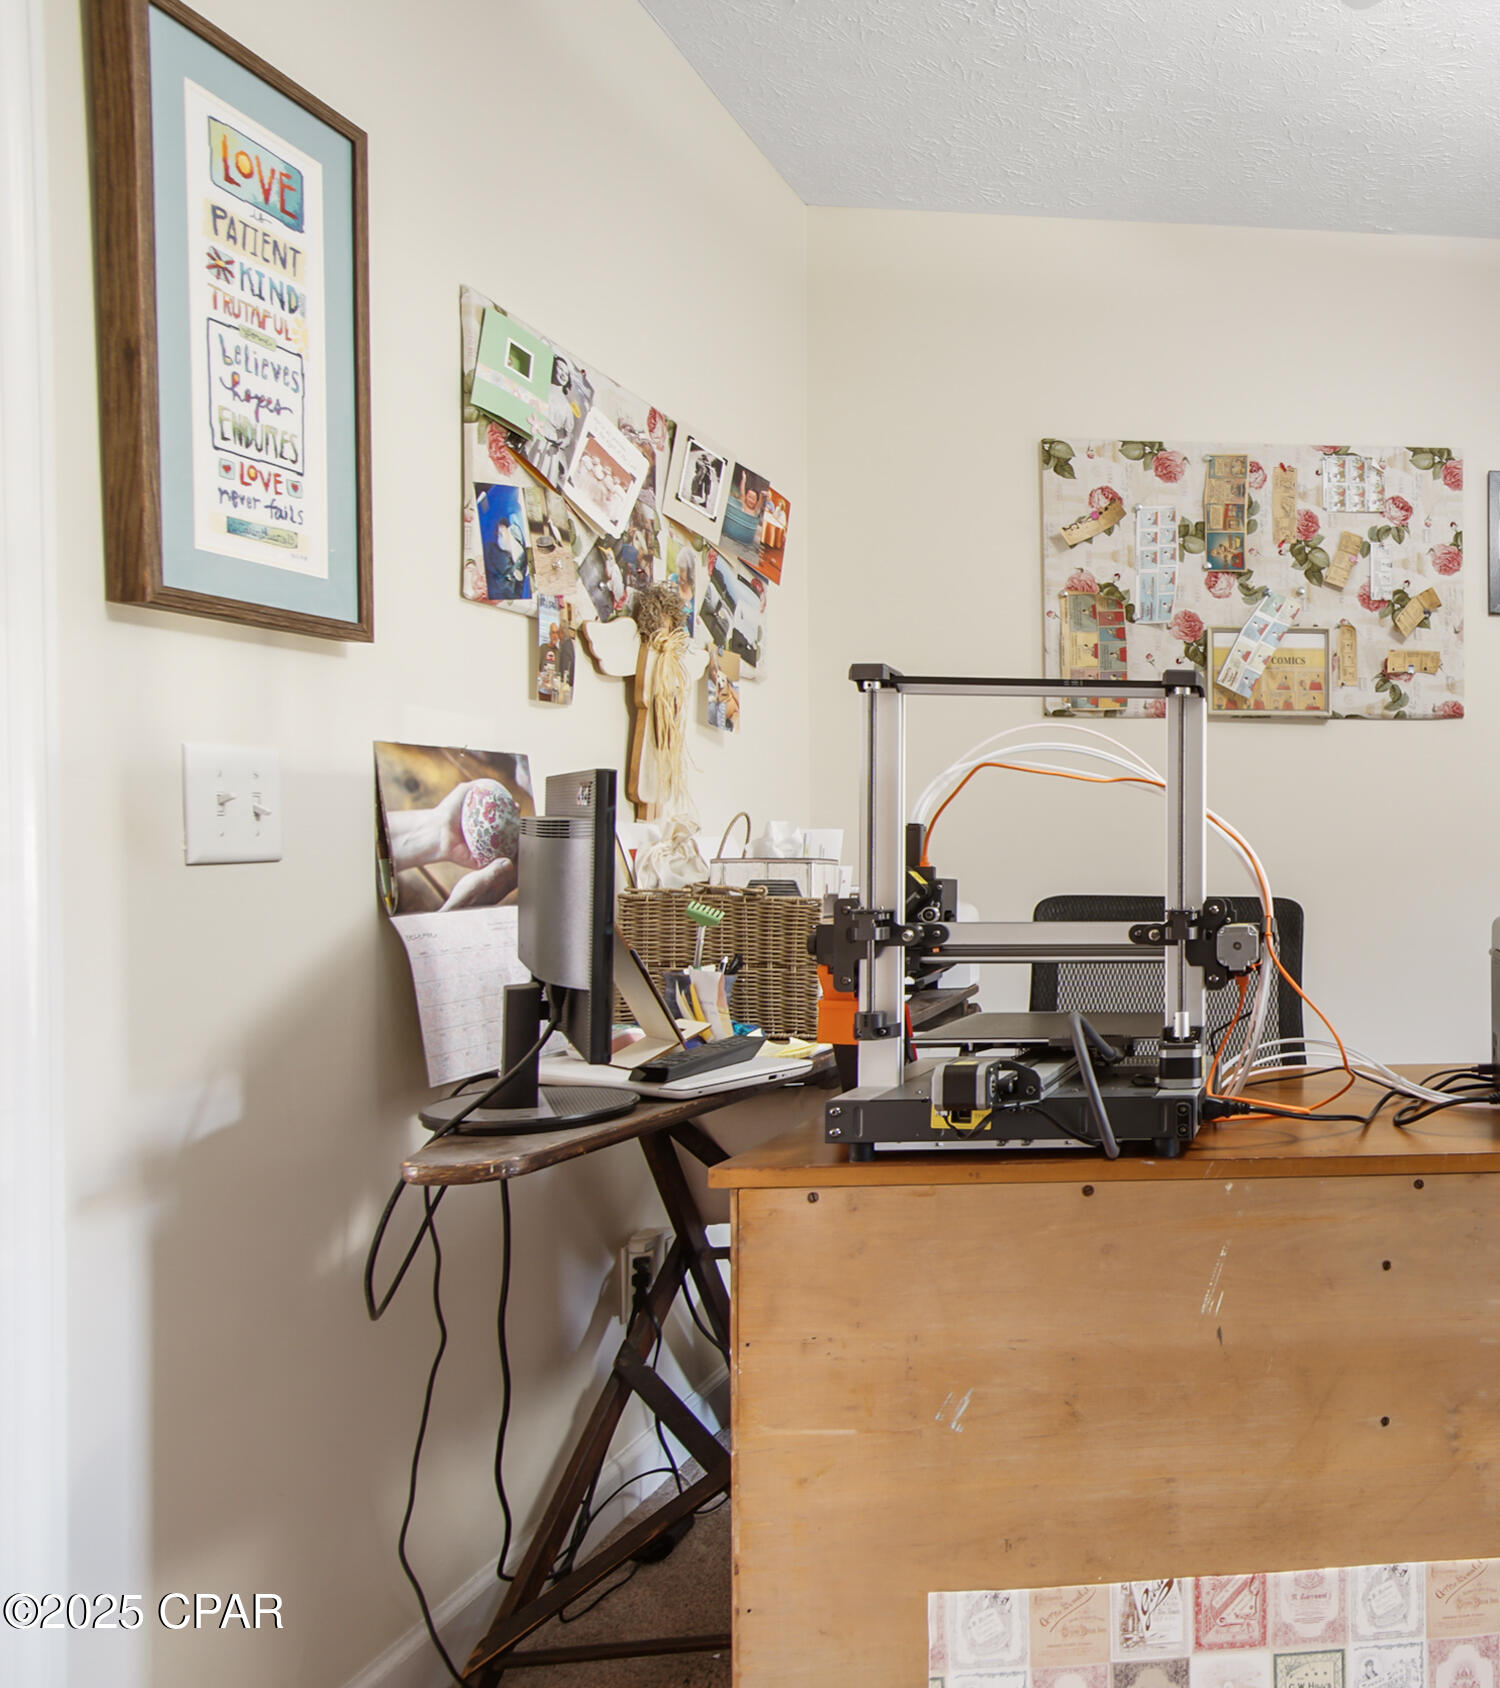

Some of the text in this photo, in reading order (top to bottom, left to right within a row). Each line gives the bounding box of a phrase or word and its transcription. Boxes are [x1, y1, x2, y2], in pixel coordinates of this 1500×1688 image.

[221, 133, 299, 220] LOVE
[211, 204, 302, 277] PATIENT
[239, 261, 300, 314] KIND
[218, 333, 300, 393] believes
[219, 371, 293, 422] hopes
[218, 404, 298, 464] ENDURES
[240, 461, 283, 495] LOVE
[218, 487, 303, 525] never fails
[1271, 656, 1306, 664] COMICS
